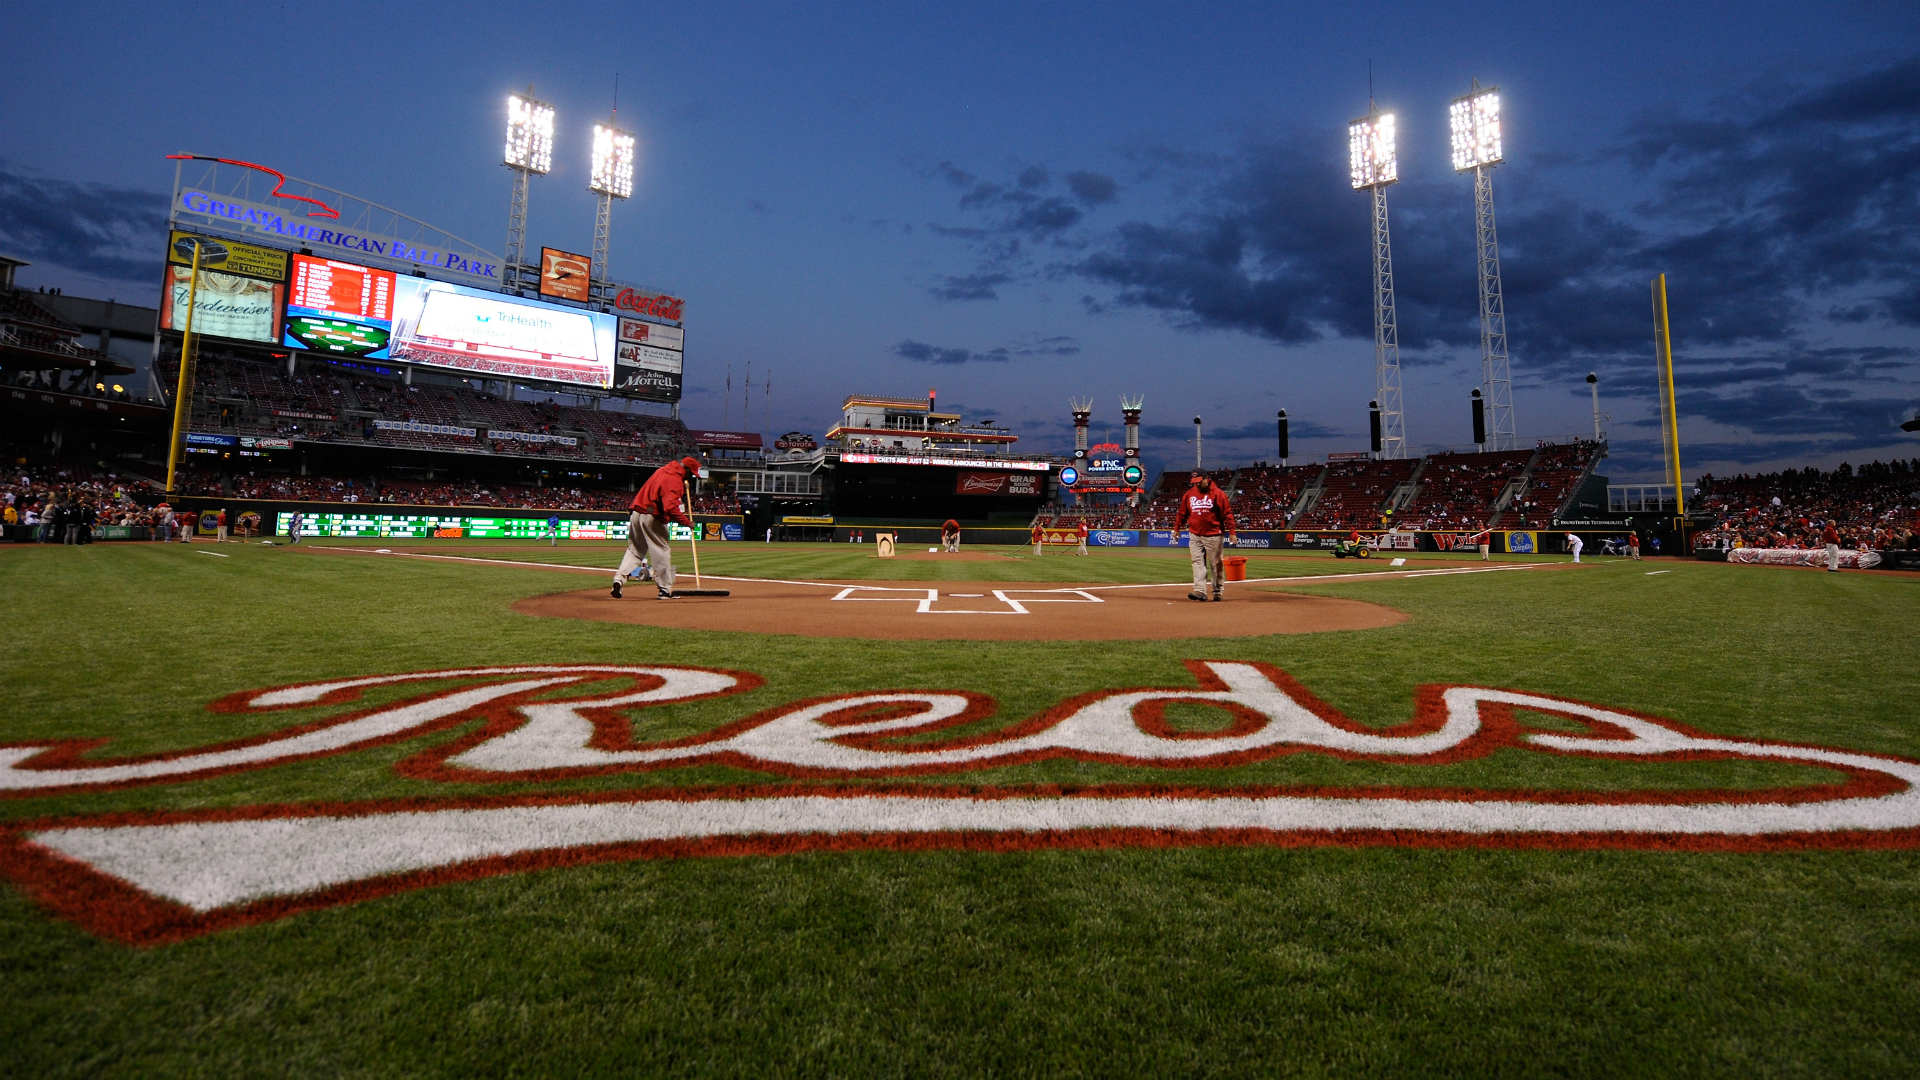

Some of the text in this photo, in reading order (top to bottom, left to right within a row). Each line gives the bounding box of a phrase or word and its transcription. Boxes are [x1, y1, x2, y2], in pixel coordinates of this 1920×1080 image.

[183, 191, 497, 277] GREAT AMERICAN BALL PARK
[241, 264, 281, 277] TUNDRA
[497, 312, 553, 329] TriHealth
[616, 375, 680, 389] Morrell
[1009, 475, 1036, 483] GRAB
[1009, 486, 1035, 494] BUDS
[1189, 495, 1214, 509] Reds
[1237, 537, 1269, 545] AMERICAN
